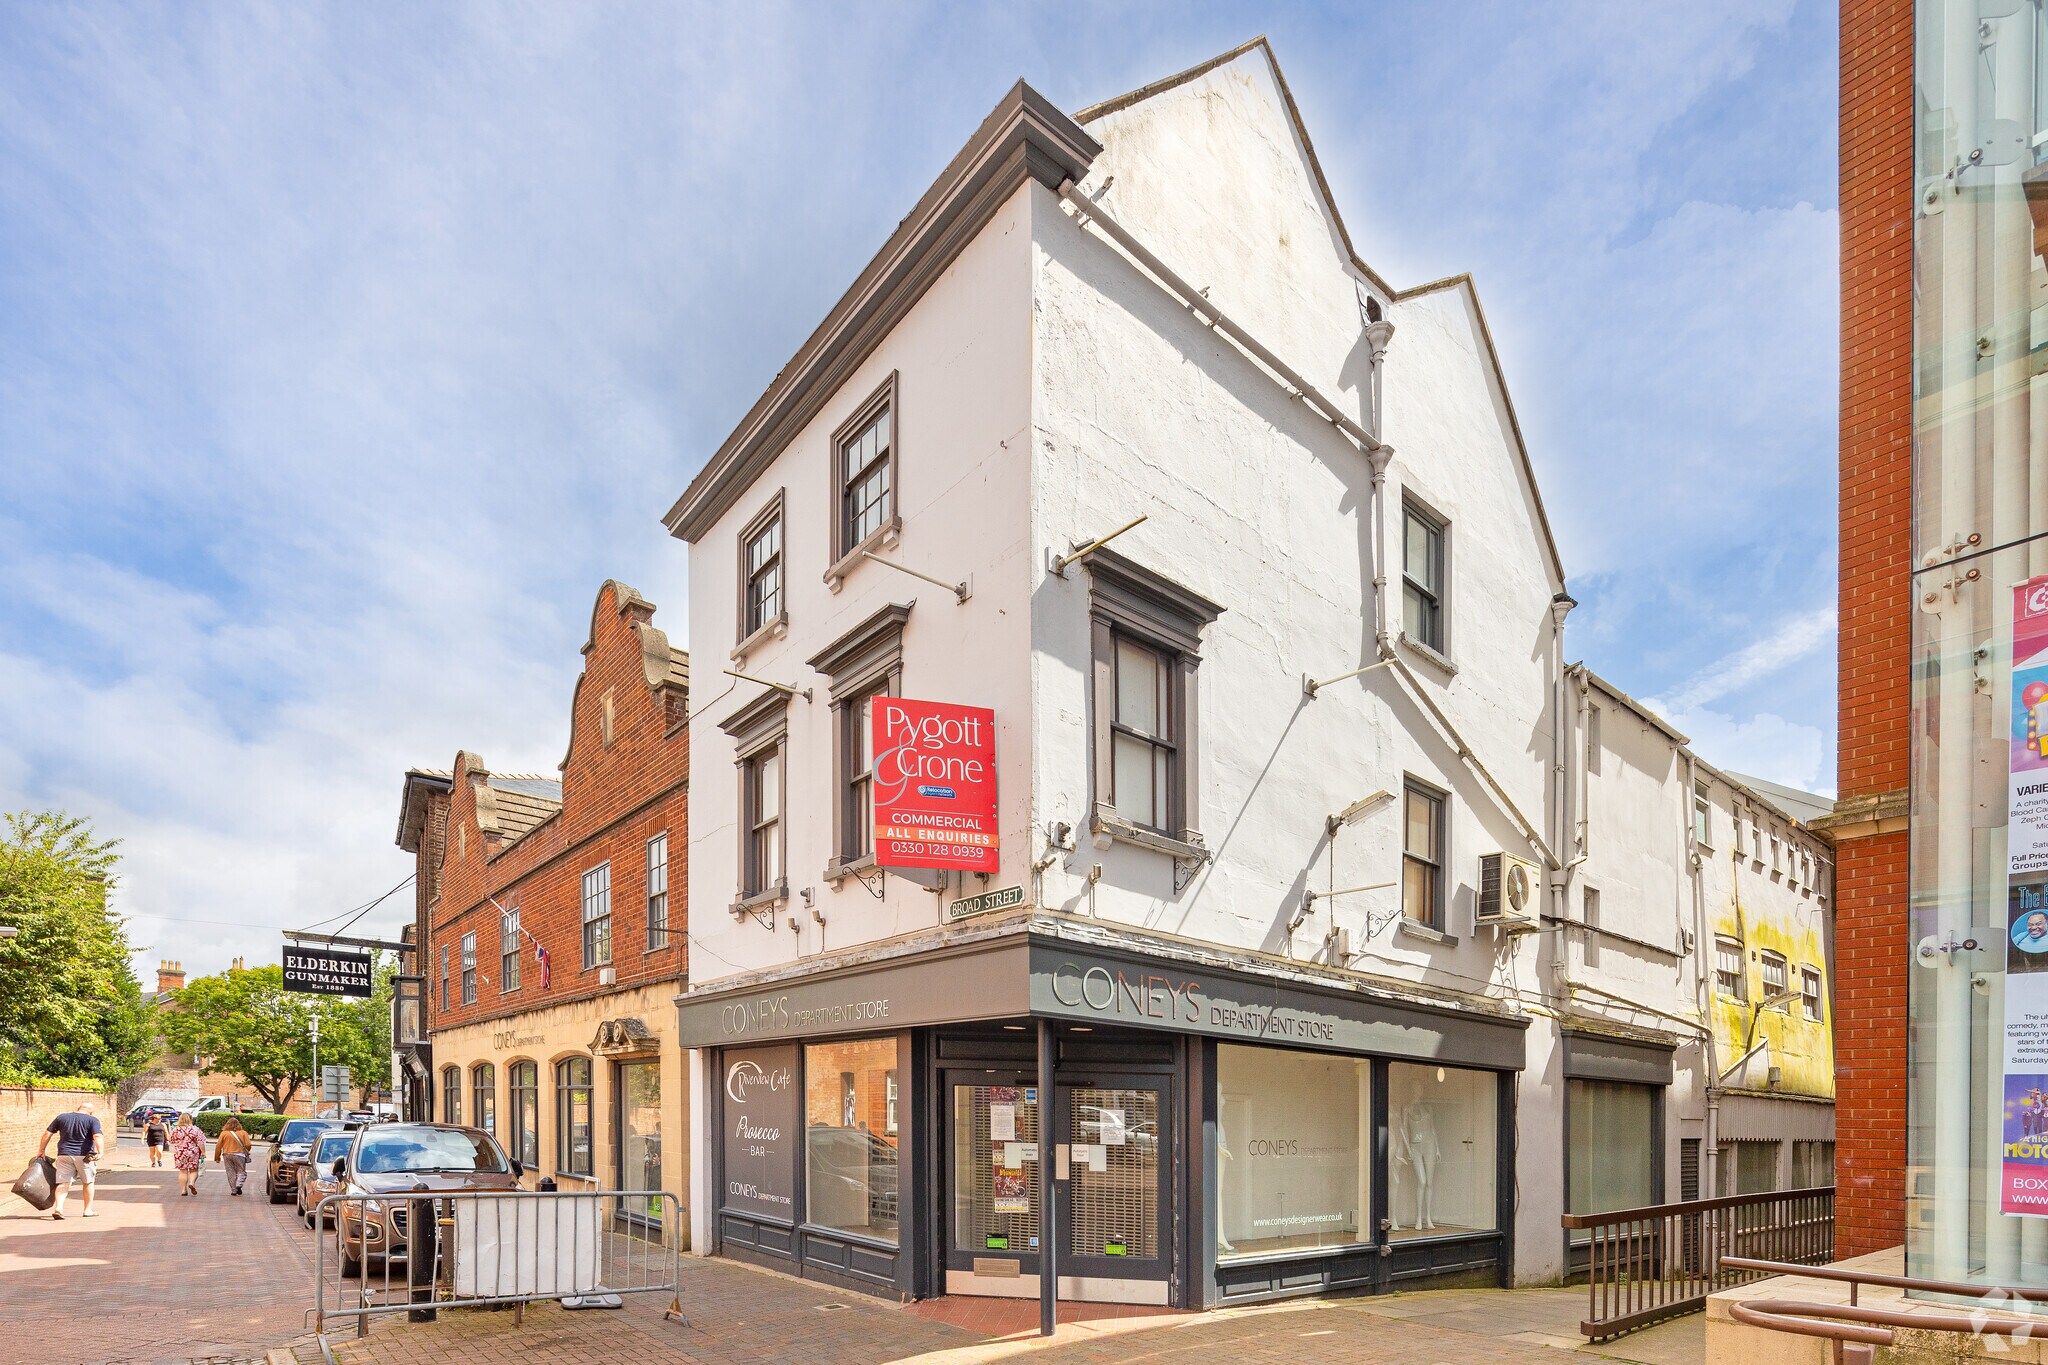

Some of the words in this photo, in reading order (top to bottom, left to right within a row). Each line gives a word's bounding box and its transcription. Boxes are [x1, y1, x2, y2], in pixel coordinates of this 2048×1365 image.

[886, 706, 982, 750] Pygott
[897, 747, 983, 783] Crone
[892, 813, 982, 830] COMMERCIAL
[2010, 808, 2033, 817] Blood
[2020, 815, 2041, 824] Zeph
[886, 827, 911, 839] ALL
[918, 829, 990, 845] ENQUIRIES
[891, 841, 924, 854] 0330
[927, 843, 949, 856] 128
[952, 845, 984, 859] 0939
[2011, 854, 2027, 862] Full
[2012, 861, 2048, 870] Groups
[952, 898, 981, 917] BROAD
[984, 889, 1020, 909] STREET
[2018, 886, 2040, 909] The
[286, 955, 368, 975] ELDERKIN
[285, 971, 369, 987] GUNMAKER
[326, 984, 345, 992] 1880
[1052, 962, 1201, 1023] CONEYS
[1210, 1006, 1295, 1035] DEPARTMENT
[1297, 1018, 1334, 1041] STORE
[722, 996, 790, 1036] CONEYS
[794, 1004, 854, 1028] DEPARTMENT
[855, 999, 889, 1021] STORE
[738, 1071, 770, 1098] Riverview
[735, 1115, 780, 1141] Prosecco
[750, 1146, 765, 1157] BAR
[1248, 1139, 1298, 1156] CONEYS
[730, 1181, 757, 1199] CONEYS
[2013, 1177, 2048, 1190] BOX
[1253, 1212, 1343, 1227] www.coneysdesignerwear.co.uk
